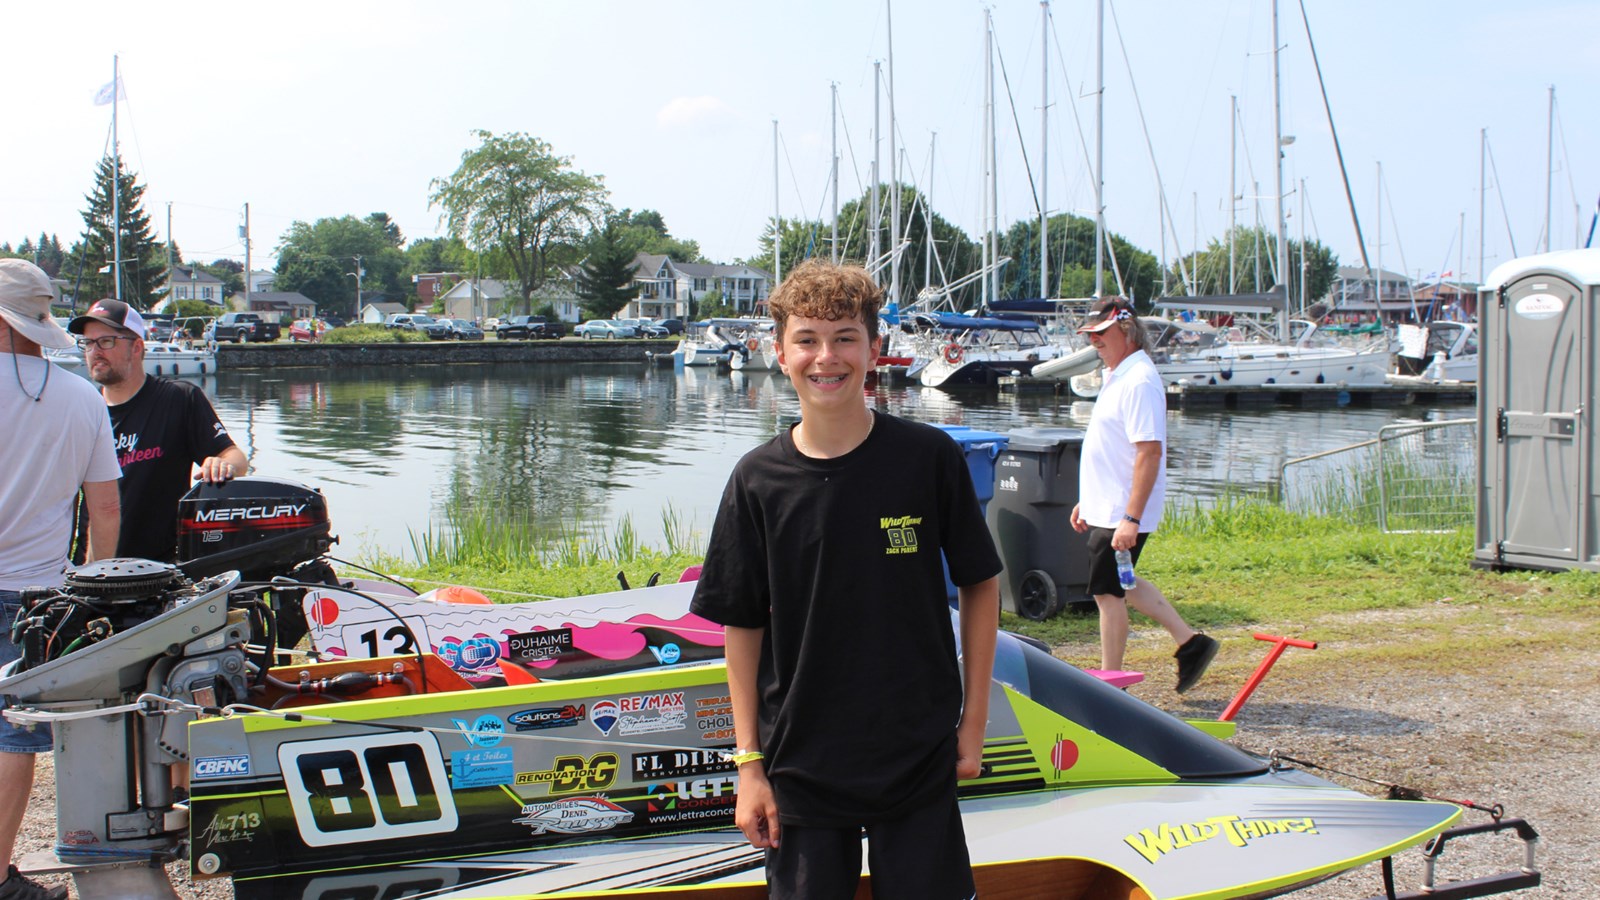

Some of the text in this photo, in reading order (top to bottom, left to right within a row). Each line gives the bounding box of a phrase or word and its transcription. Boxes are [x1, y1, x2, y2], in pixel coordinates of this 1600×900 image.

[114, 432, 138, 452] cky
[195, 503, 307, 522] MERCURY
[202, 530, 223, 543] 15
[887, 527, 918, 548] 80
[361, 626, 415, 658] 13
[511, 633, 570, 651] DUHAIME
[521, 645, 562, 659] CRISTEA
[620, 693, 684, 712] RE/MAX
[698, 717, 734, 731] CHOL
[196, 759, 248, 774] CBFNC
[636, 748, 738, 772] FL DIES
[518, 769, 598, 783] RENOVATION
[643, 764, 737, 778] SERVICE MOBI
[296, 742, 443, 833] 80
[677, 776, 739, 800] LETT
[522, 801, 579, 813] AUTOMOBILES
[561, 809, 588, 819] DENIS
[649, 807, 736, 823] www.lettraconce
[227, 812, 262, 831] 713
